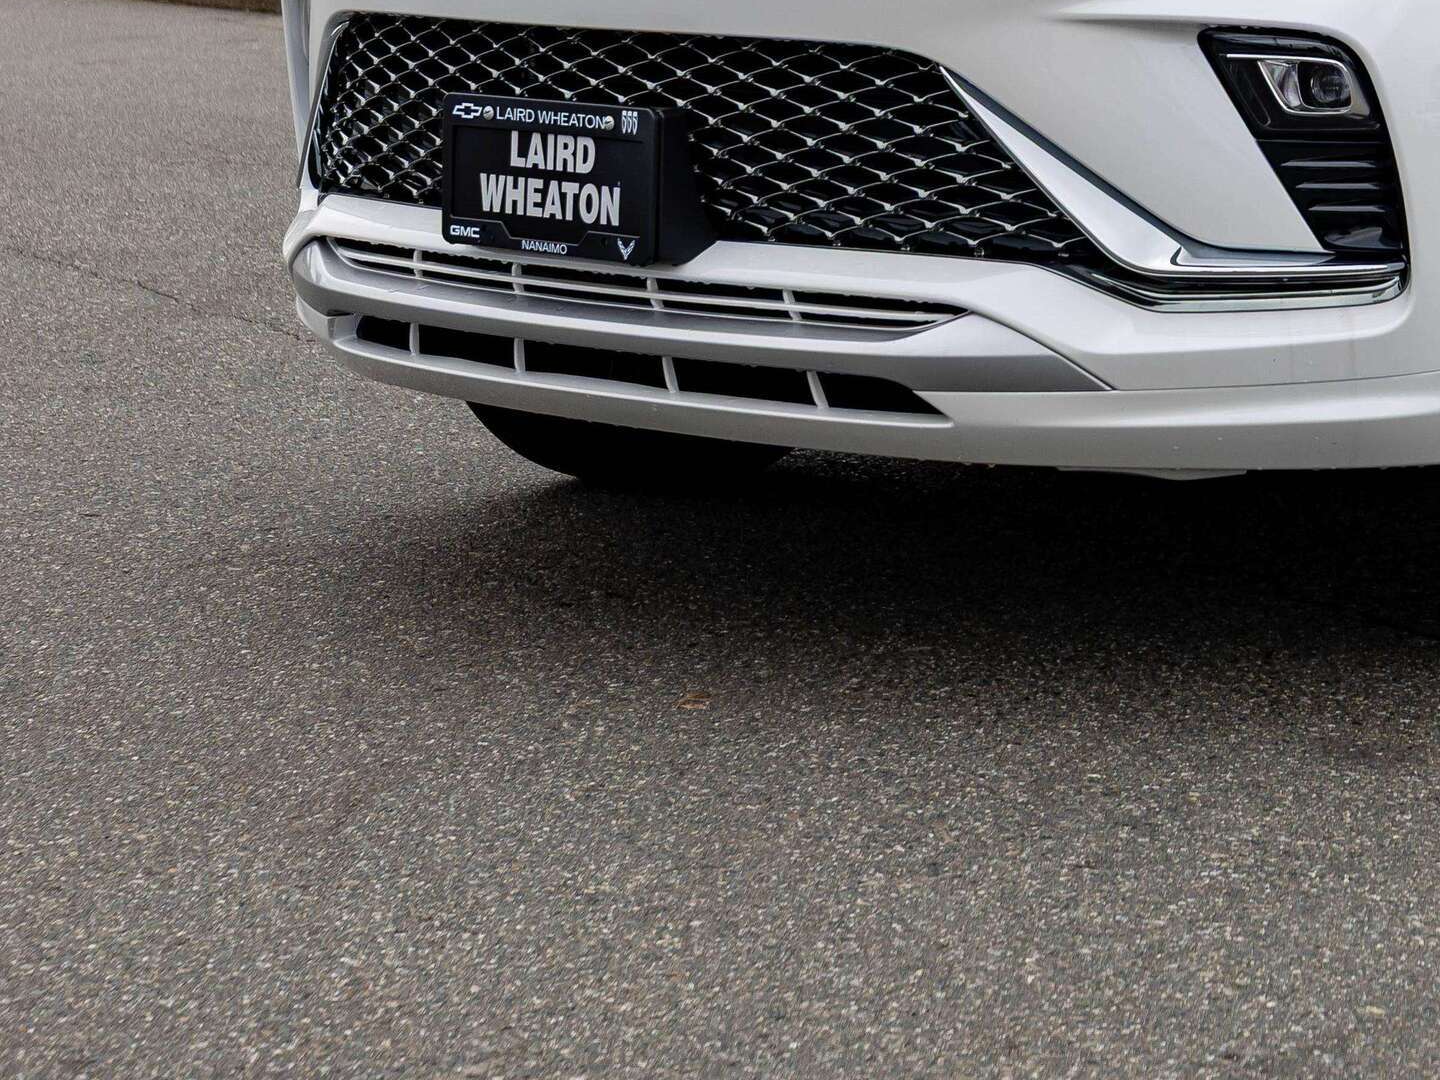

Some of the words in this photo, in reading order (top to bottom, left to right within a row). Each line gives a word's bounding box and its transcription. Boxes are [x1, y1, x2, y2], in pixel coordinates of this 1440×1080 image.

[496, 106, 535, 123] LAIRD
[538, 110, 605, 129] WHEATON
[510, 130, 596, 174] LAIRD
[480, 173, 620, 226] WHEATON
[450, 224, 480, 238] GMC
[521, 239, 568, 255] NANAIMO
